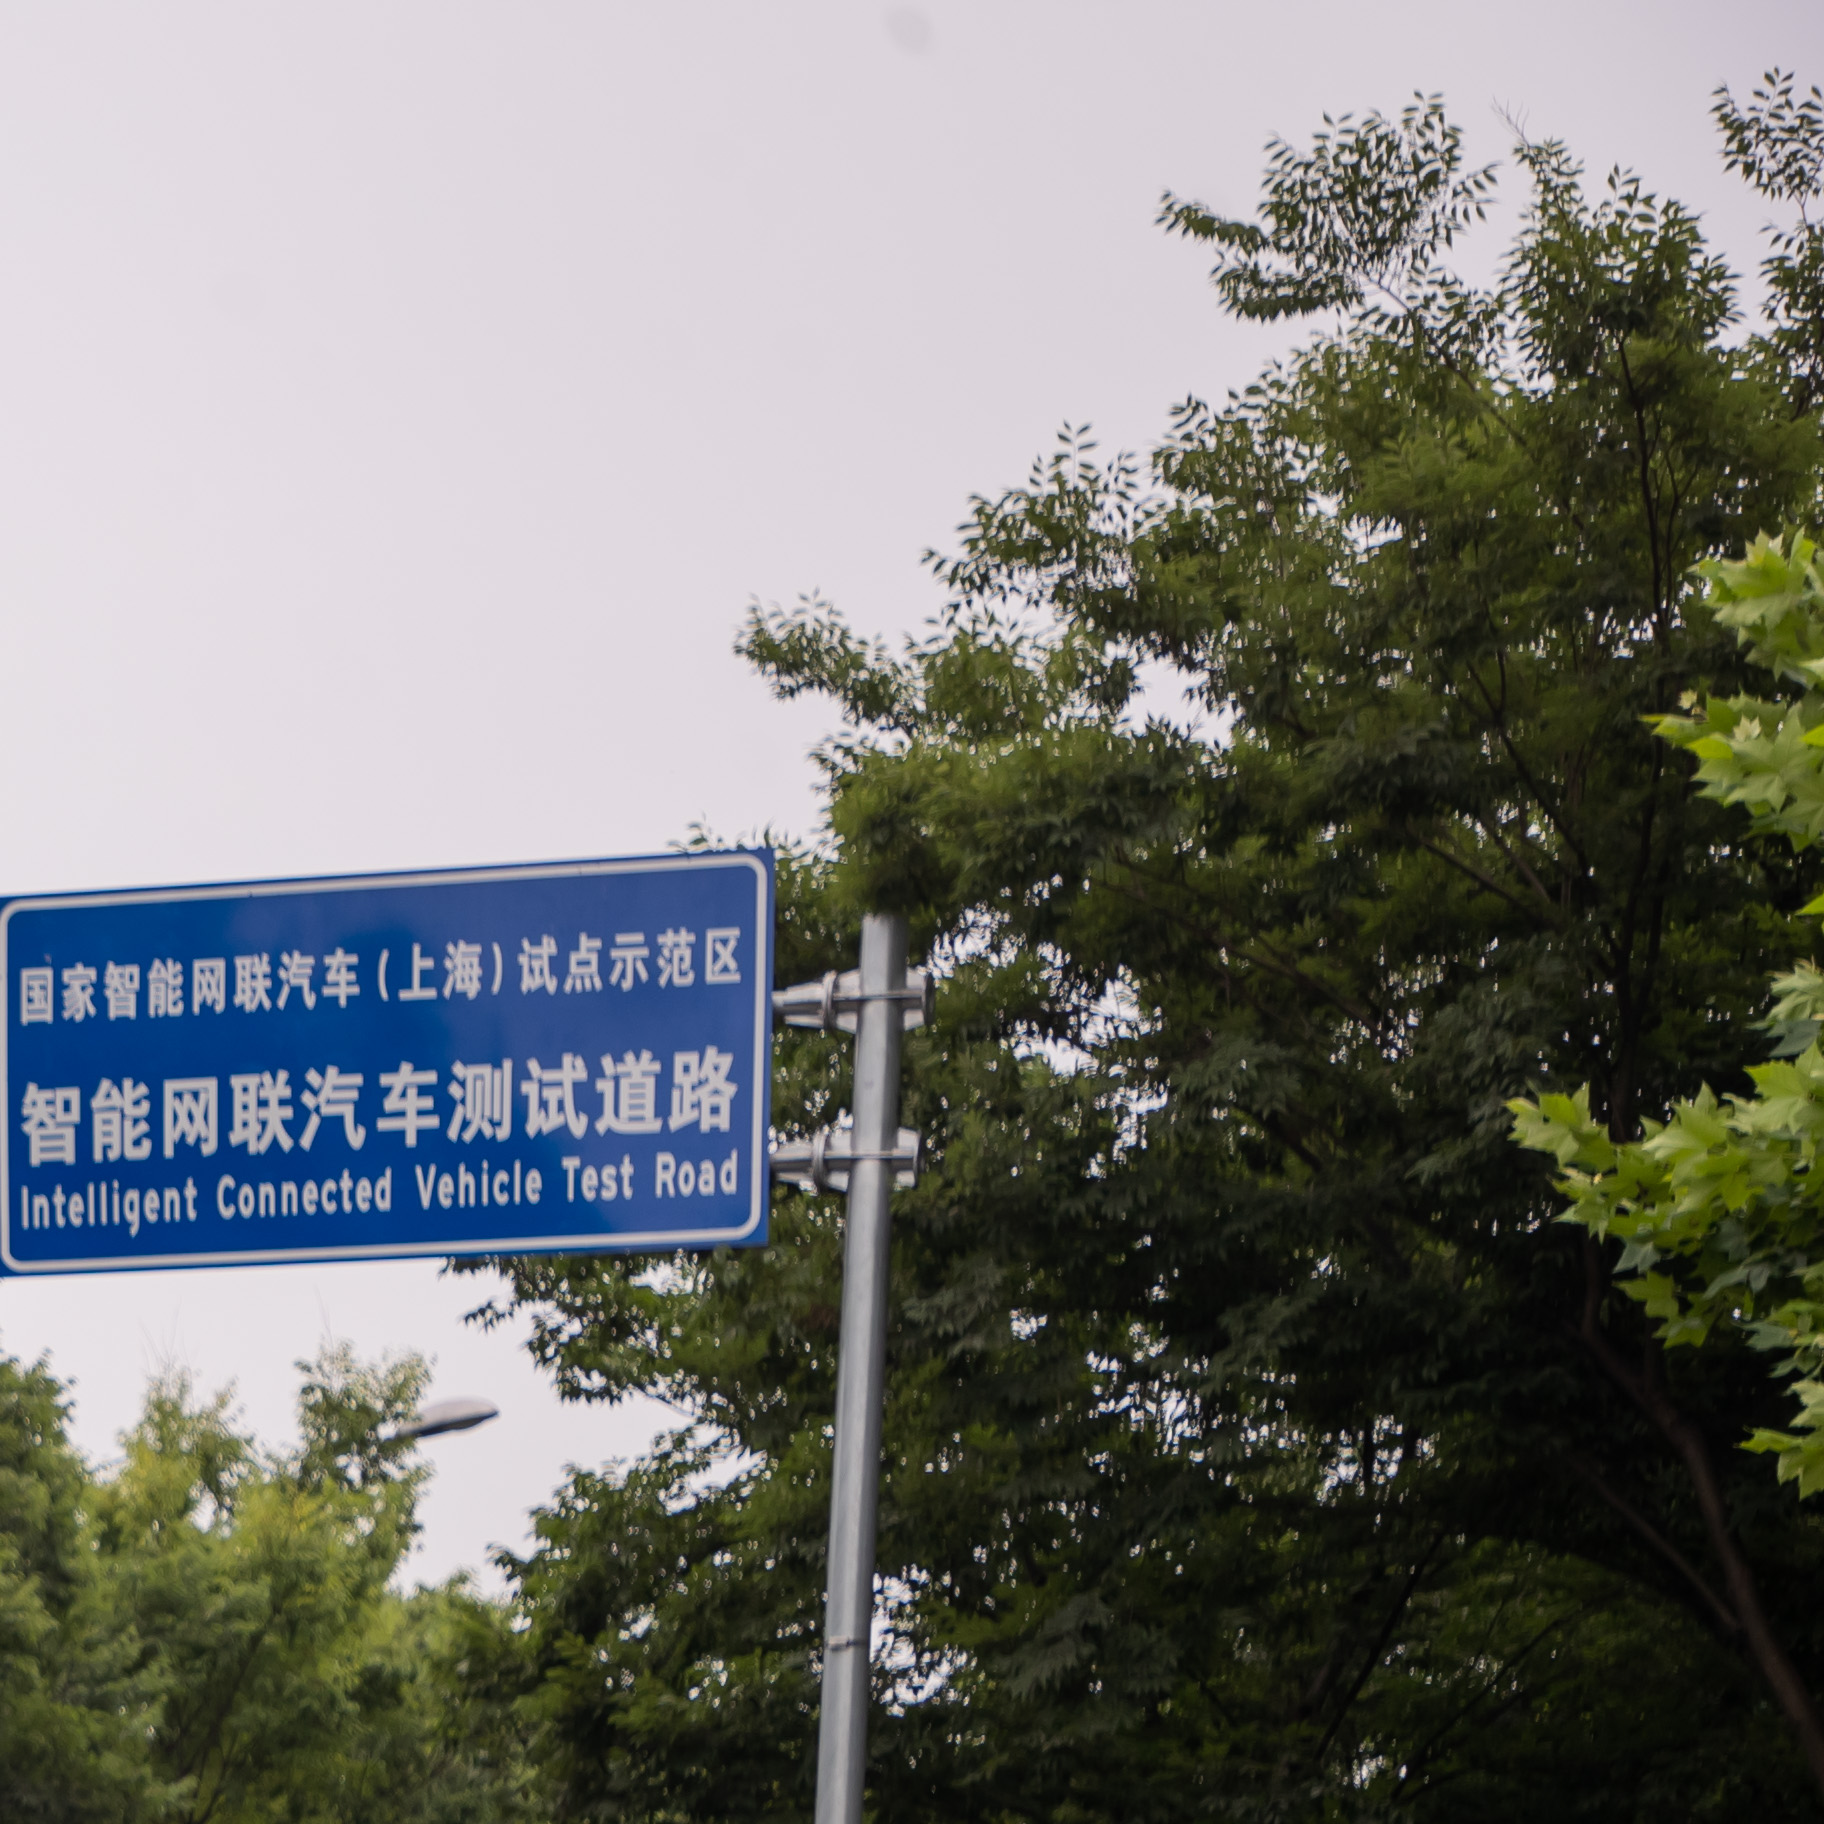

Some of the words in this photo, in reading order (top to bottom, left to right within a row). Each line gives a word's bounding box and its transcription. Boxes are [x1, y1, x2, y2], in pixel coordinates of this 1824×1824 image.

[23, 1046, 737, 1166] 智能网联汽车测试道路
[22, 1178, 197, 1236] Intelligent
[217, 1167, 392, 1218] Connected
[416, 1160, 542, 1209] Vehicle
[562, 1154, 635, 1201] Test
[655, 1148, 738, 1197] Road
